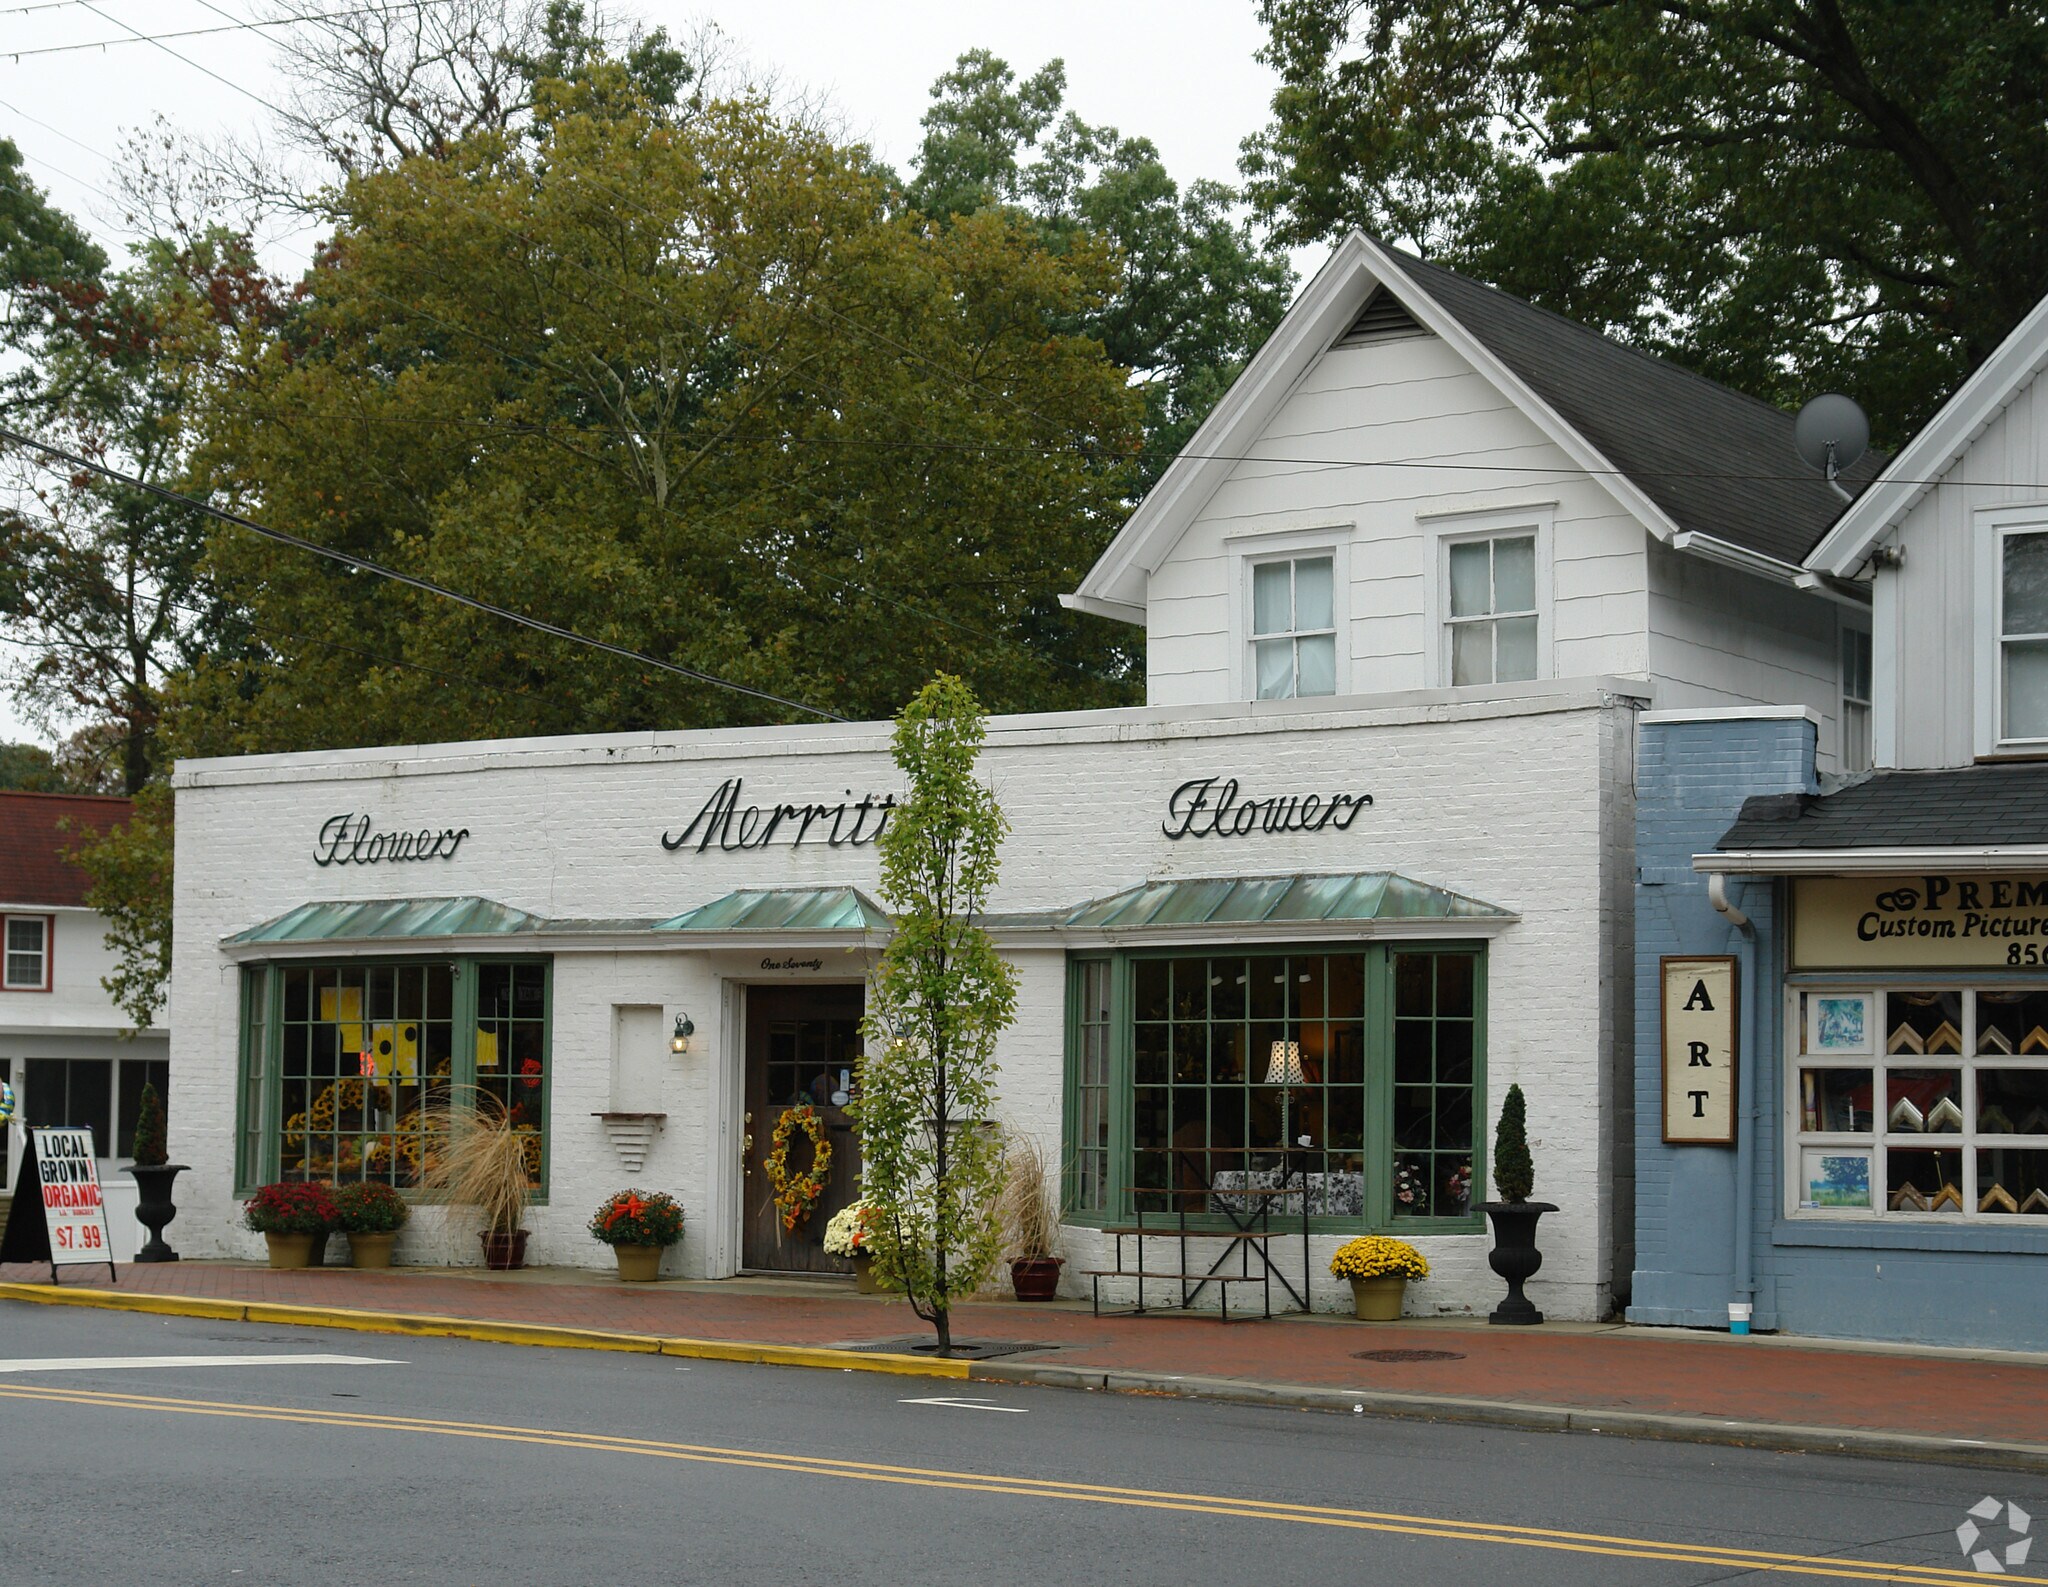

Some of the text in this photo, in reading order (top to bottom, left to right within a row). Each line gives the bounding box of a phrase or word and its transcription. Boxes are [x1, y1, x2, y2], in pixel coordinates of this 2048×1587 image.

[661, 777, 897, 854] Merritt
[1161, 776, 1374, 840] Flowers
[313, 812, 469, 867] Flowers
[1857, 911, 2048, 941] Custom Picture
[760, 957, 823, 972] One Seventy
[1682, 979, 1715, 1117] ART
[42, 1135, 88, 1158] LOCAL
[40, 1159, 95, 1183] GROWN!
[42, 1184, 102, 1208] ORGANIC
[56, 1225, 102, 1249] $7.99
